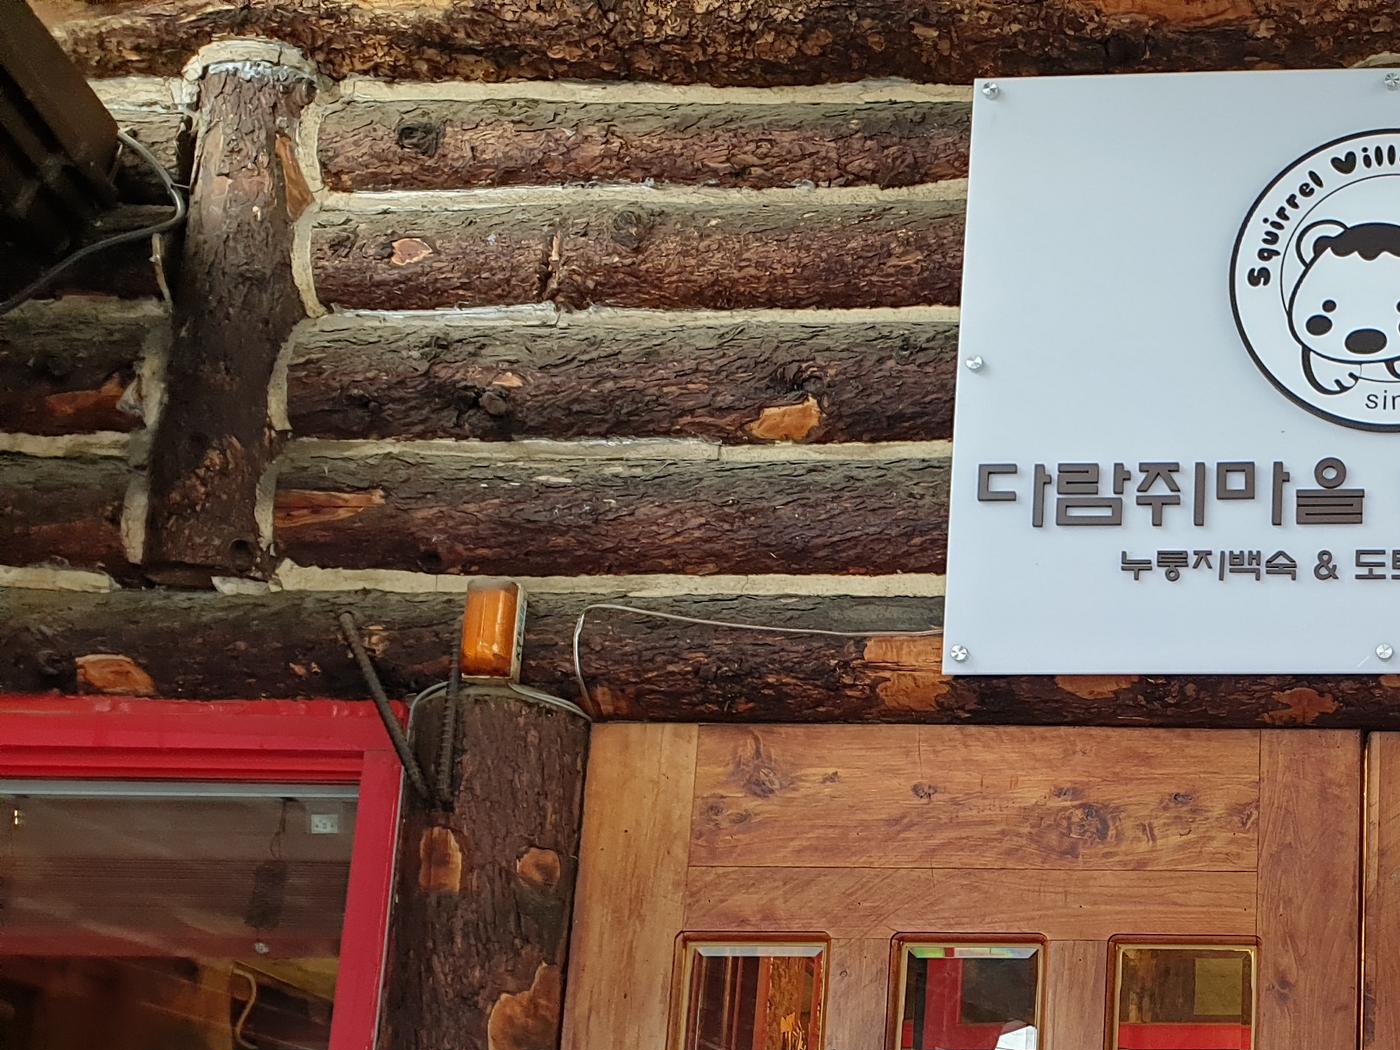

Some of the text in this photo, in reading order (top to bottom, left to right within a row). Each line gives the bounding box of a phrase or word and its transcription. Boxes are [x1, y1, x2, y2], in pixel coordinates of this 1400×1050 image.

[1247, 168, 1326, 287] Squirrel
[976, 457, 1367, 528] 다람쥐마을
[1119, 549, 1298, 583] 누룽지백숙
[1313, 551, 1340, 581] &
